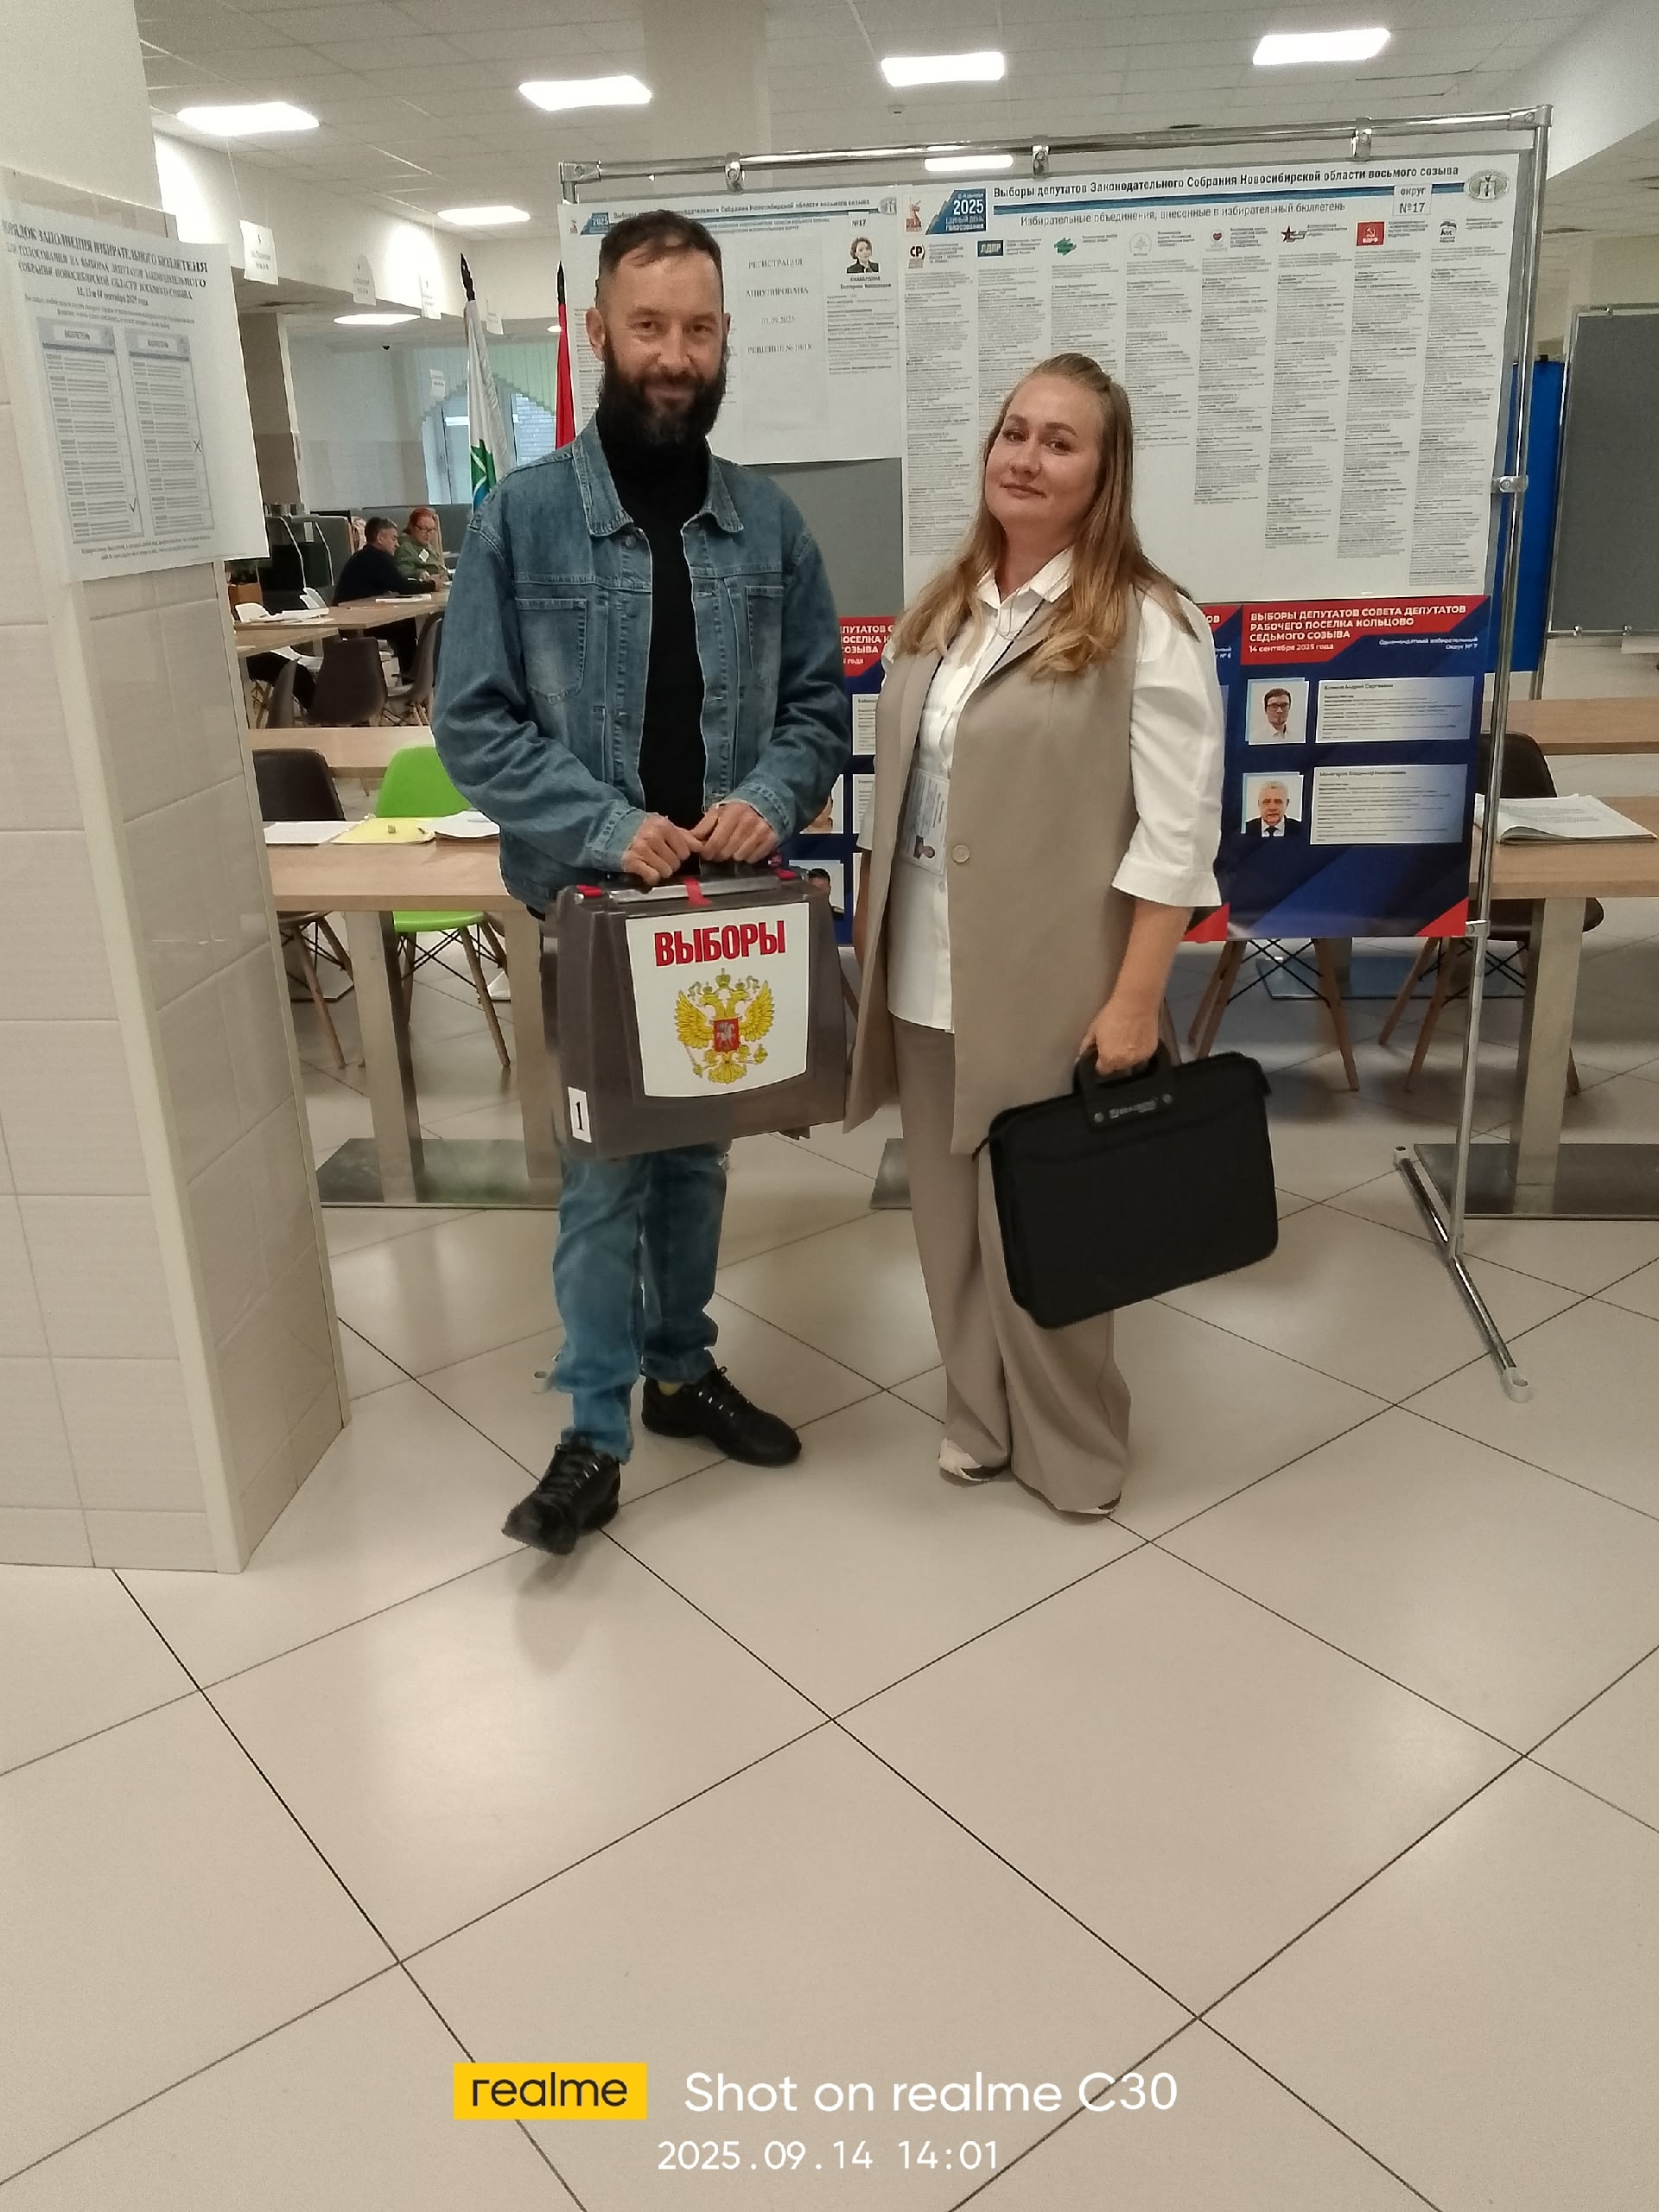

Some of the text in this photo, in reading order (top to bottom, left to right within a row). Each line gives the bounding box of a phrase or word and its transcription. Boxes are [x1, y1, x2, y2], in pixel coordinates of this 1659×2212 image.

[994, 187, 1034, 199] Выборы
[1038, 184, 1087, 197] депутатов
[1090, 177, 1184, 193] Законодательного
[1187, 175, 1237, 188] Собрания
[1240, 170, 1321, 185] Новосибирской
[1324, 169, 1366, 181] области
[1369, 168, 1417, 179] восьмого
[1420, 167, 1459, 176] созыва
[1400, 187, 1426, 198] округ
[953, 199, 984, 215] 2025
[1020, 214, 1091, 227] Избирательные
[1094, 211, 1158, 222] объединения,
[1160, 207, 1211, 219] внесенные
[1222, 203, 1294, 217] избирательный
[1296, 201, 1345, 213] бюллетень
[1399, 202, 1426, 214] №17
[1250, 605, 1466, 621] ВЫБОРЫ ДЕПУТАТОВ СОВЕТА ДЕПУТАТОВ
[840, 625, 886, 634] ПУТАТОВ
[1250, 617, 1414, 632] РАБОЧЕГО ПОСЕЛКА КОЛЬЦОВО
[1249, 630, 1351, 643] СЕДЬМОГО СОЗЫВА
[1258, 644, 1295, 652] сентября
[654, 920, 785, 966] ВЫБОРЫ
[575, 1101, 583, 1132] 1
